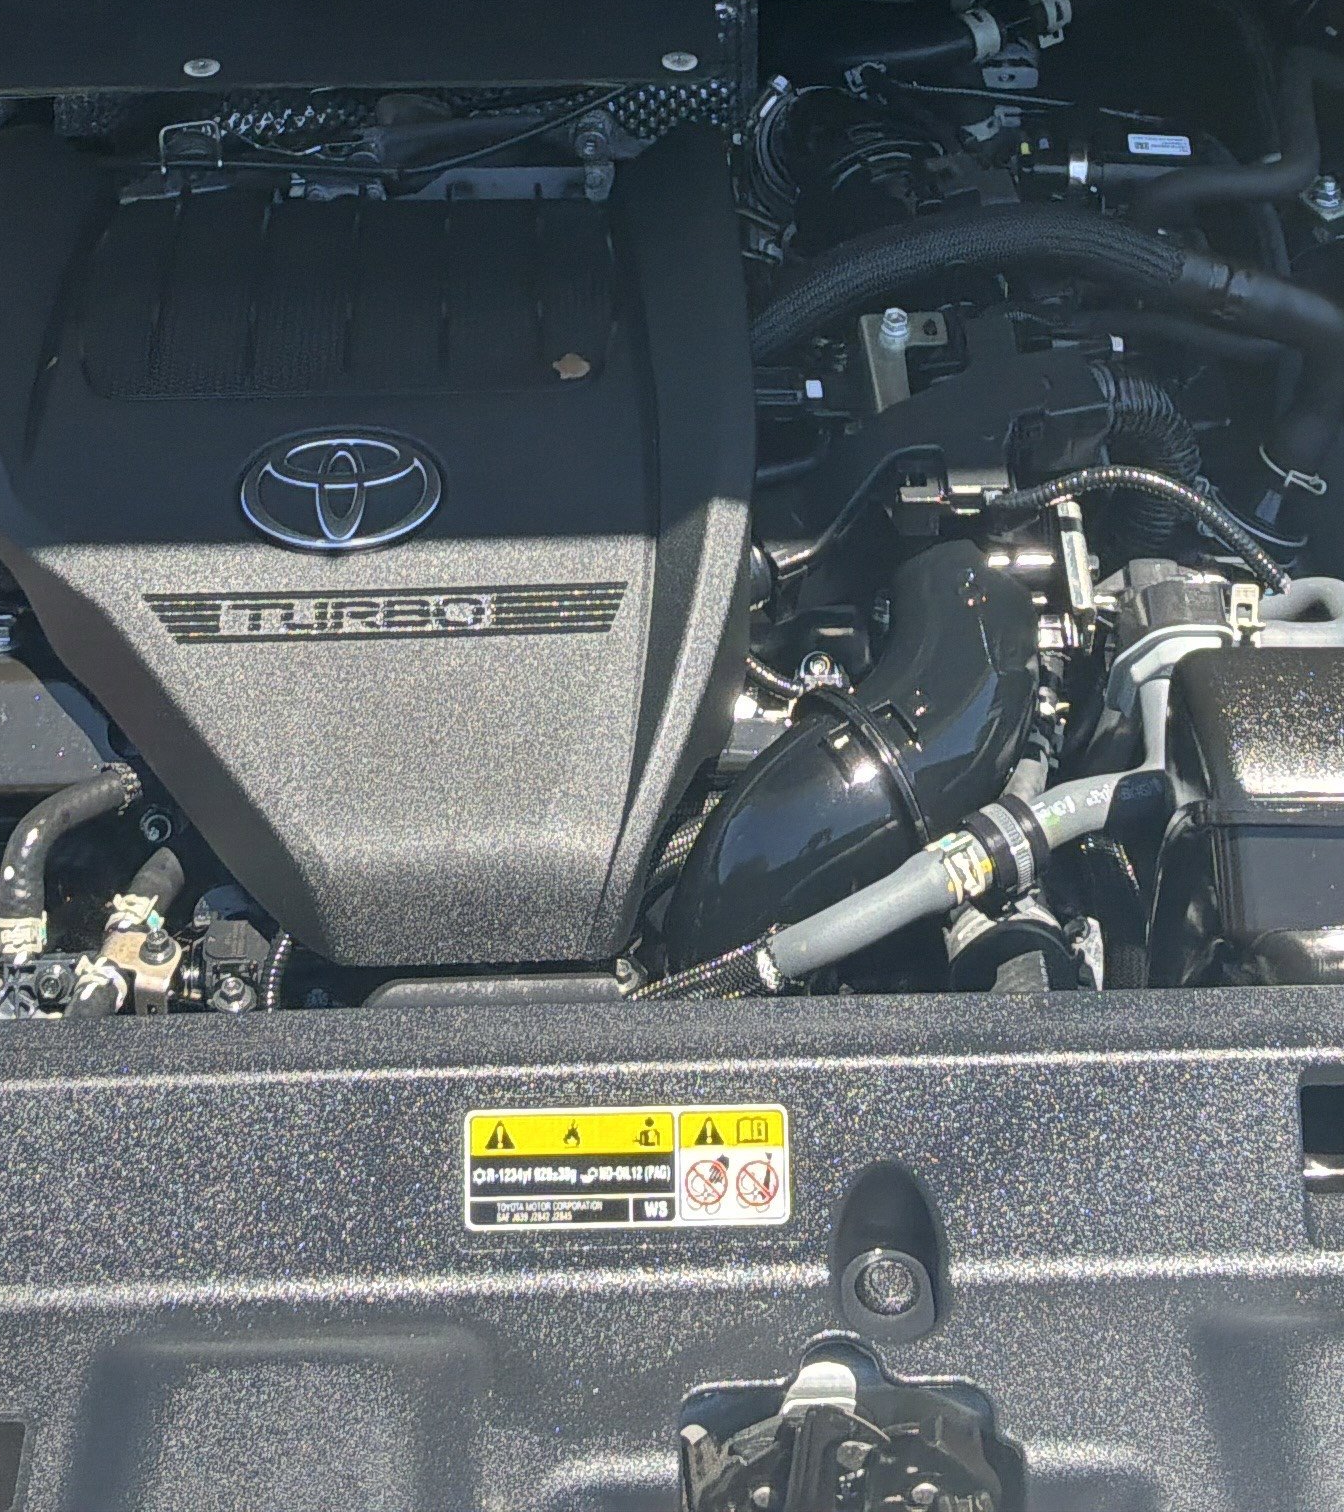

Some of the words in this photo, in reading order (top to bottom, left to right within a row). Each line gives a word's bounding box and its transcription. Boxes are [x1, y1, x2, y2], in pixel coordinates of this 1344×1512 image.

[223, 596, 490, 634] TURBO
[644, 1164, 672, 1183] (PAG)
[496, 1201, 524, 1213] TOYOTA
[525, 1201, 551, 1212] MOTOR
[552, 1199, 603, 1212] CORPORATION
[644, 1201, 669, 1219] WS
